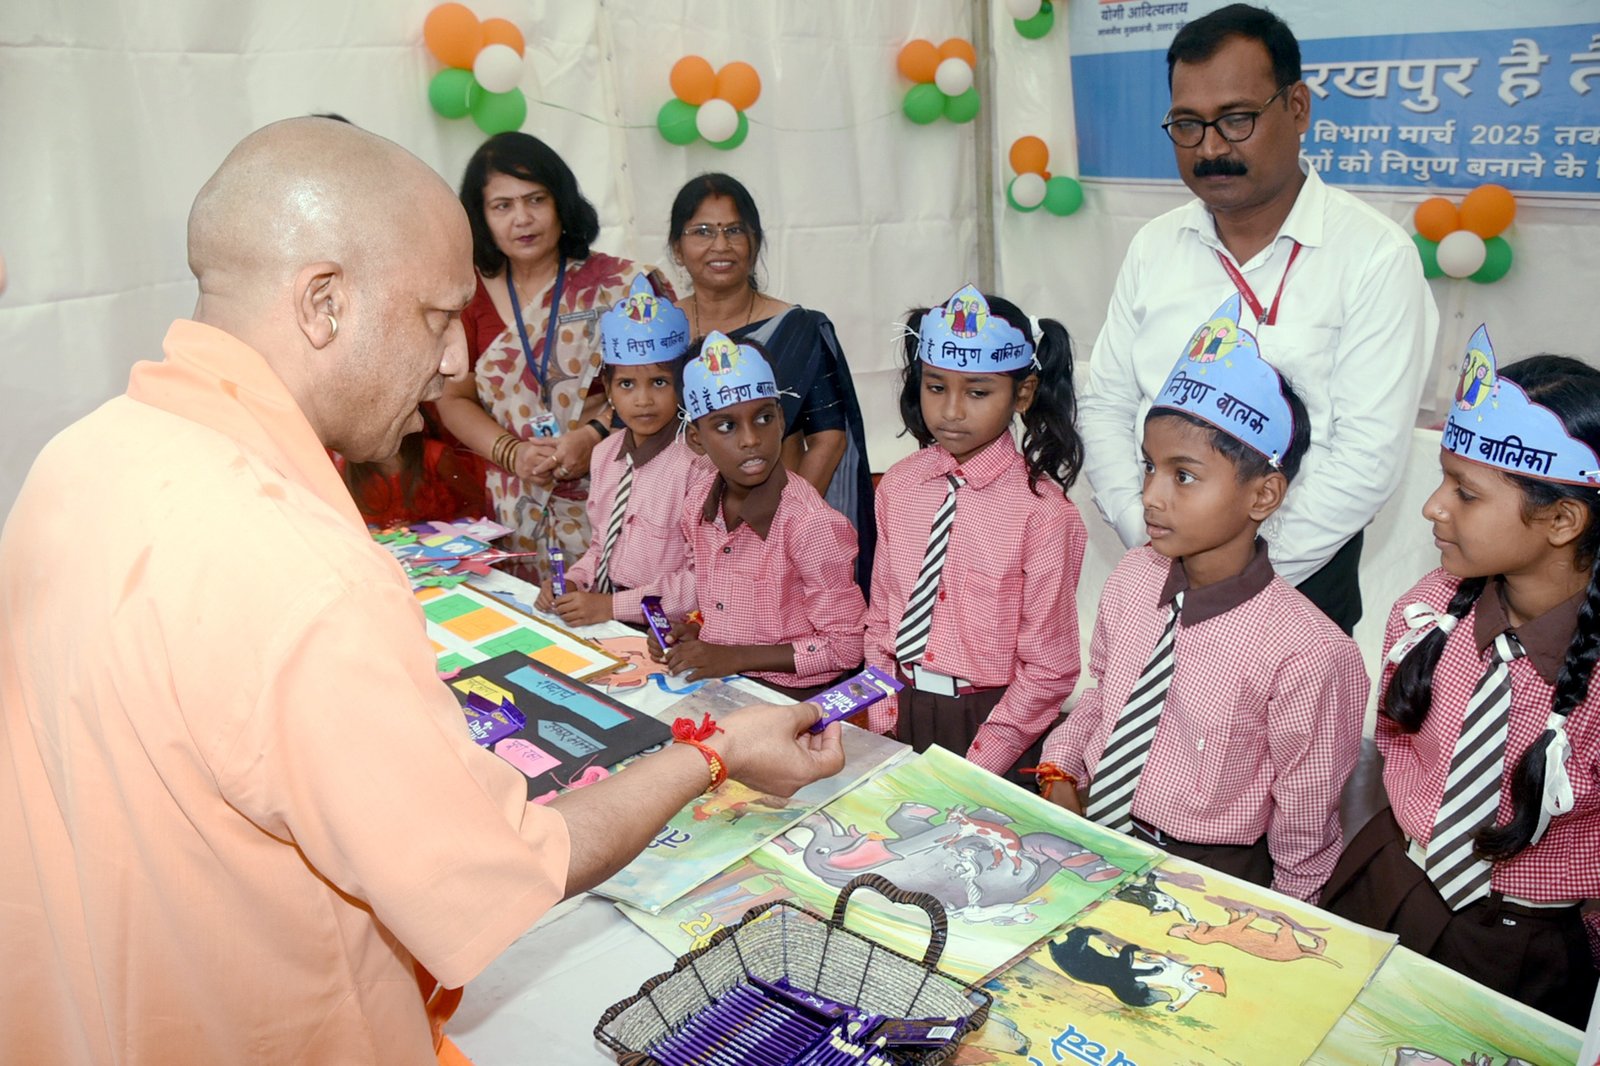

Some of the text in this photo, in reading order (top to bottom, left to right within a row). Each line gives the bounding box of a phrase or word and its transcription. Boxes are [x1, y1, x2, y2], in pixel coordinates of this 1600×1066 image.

[1301, 58, 1480, 113] रखपुर
[1498, 38, 1550, 107] है
[1314, 119, 1391, 143] विभाग
[1398, 119, 1456, 144] मार्च
[1470, 125, 1540, 145] 2025
[1338, 149, 1373, 173] को
[1380, 150, 1459, 181] निपुण
[1467, 152, 1546, 178] बनाने
[1554, 152, 1587, 178] के
[627, 338, 655, 356] निपुण
[942, 341, 981, 367] निपुण
[991, 342, 1025, 363] बालिका
[717, 385, 751, 404] निपुण
[1164, 371, 1269, 434] निपुण बालक
[1446, 415, 1557, 475] निपुण बालिका
[822, 694, 851, 713] Dairy
[469, 720, 489, 739] Dairy
